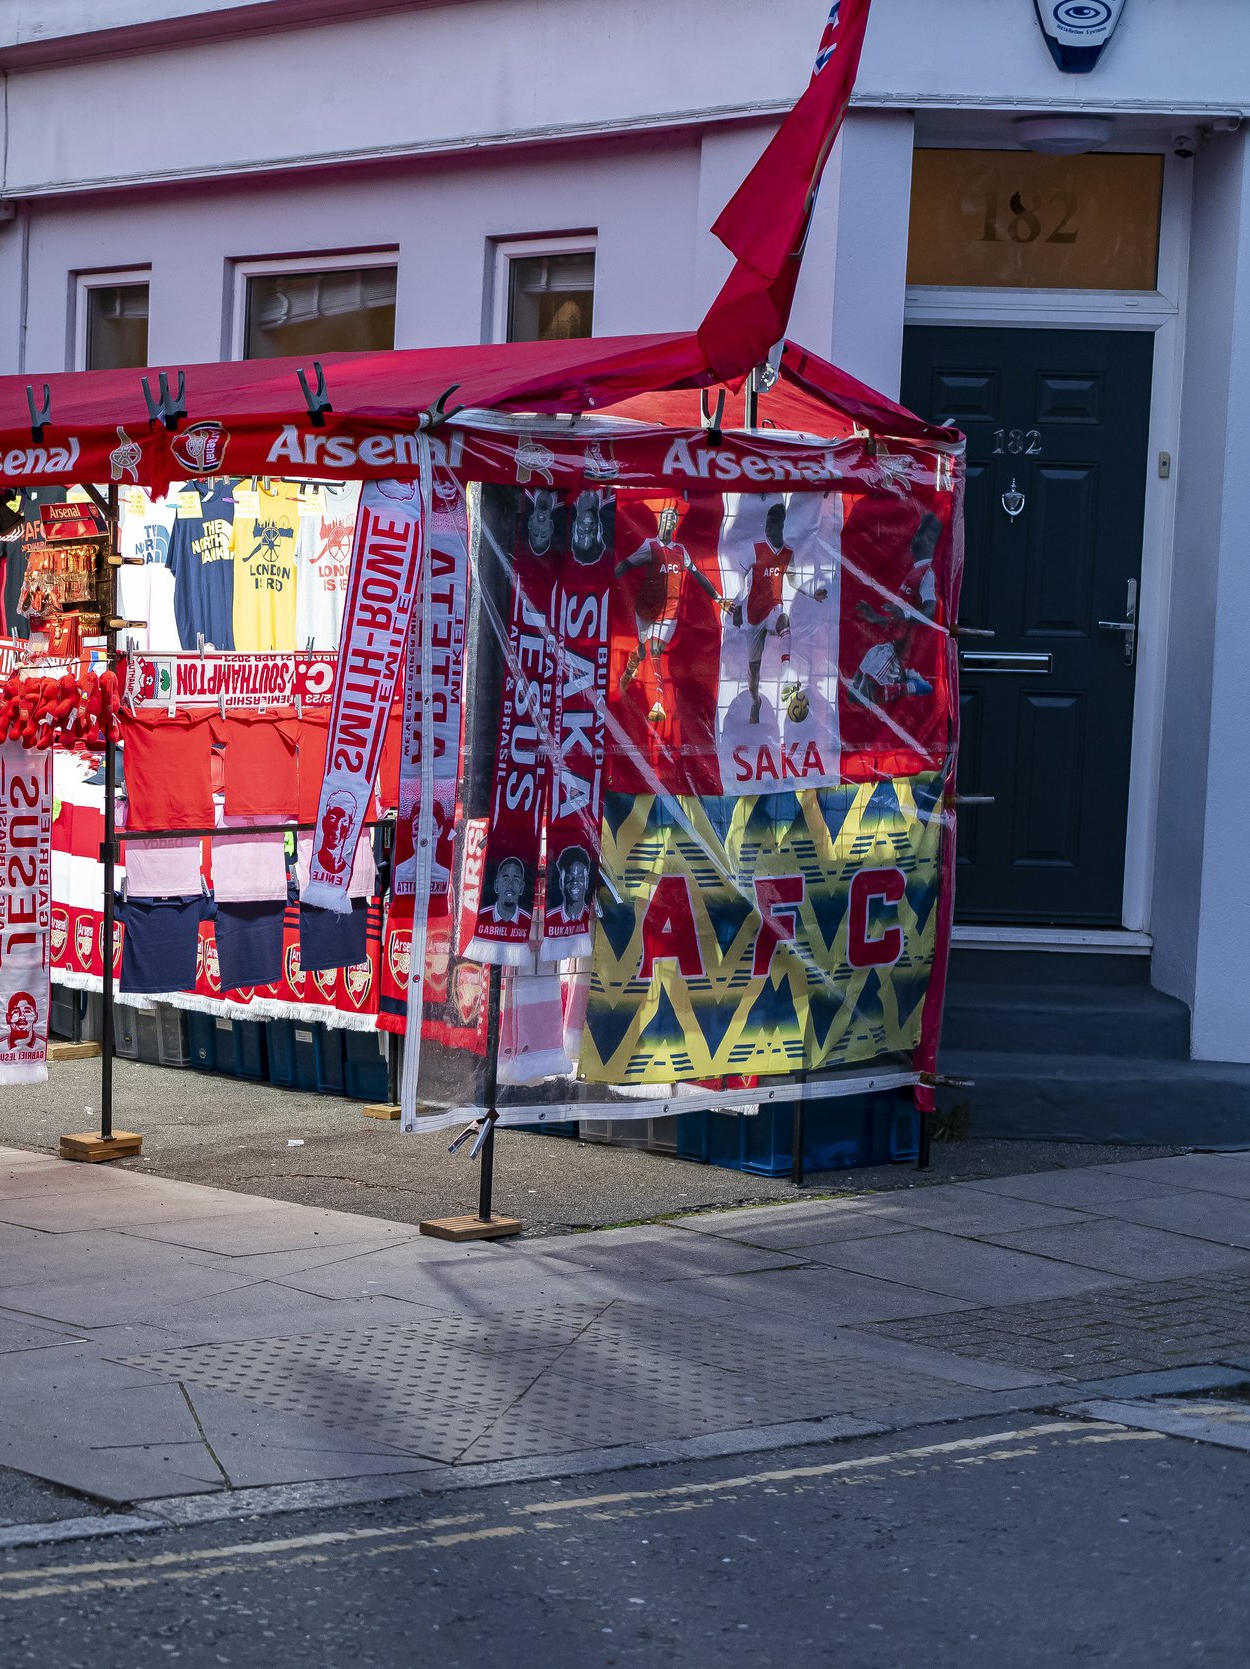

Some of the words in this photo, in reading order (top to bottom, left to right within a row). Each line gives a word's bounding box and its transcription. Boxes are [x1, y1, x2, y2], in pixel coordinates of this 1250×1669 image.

[977, 188, 1080, 245] 182
[662, 438, 843, 481] Arsenal
[991, 429, 1043, 455] 182
[49, 504, 81, 519] Arsenal
[659, 563, 679, 574] AFC
[763, 567, 780, 577] AFC
[177, 663, 289, 696] SOUTHAMPTON
[506, 599, 546, 812] JESUS
[559, 595, 599, 820] SAKA
[733, 741, 827, 782] SAKA
[636, 866, 908, 981] AFC
